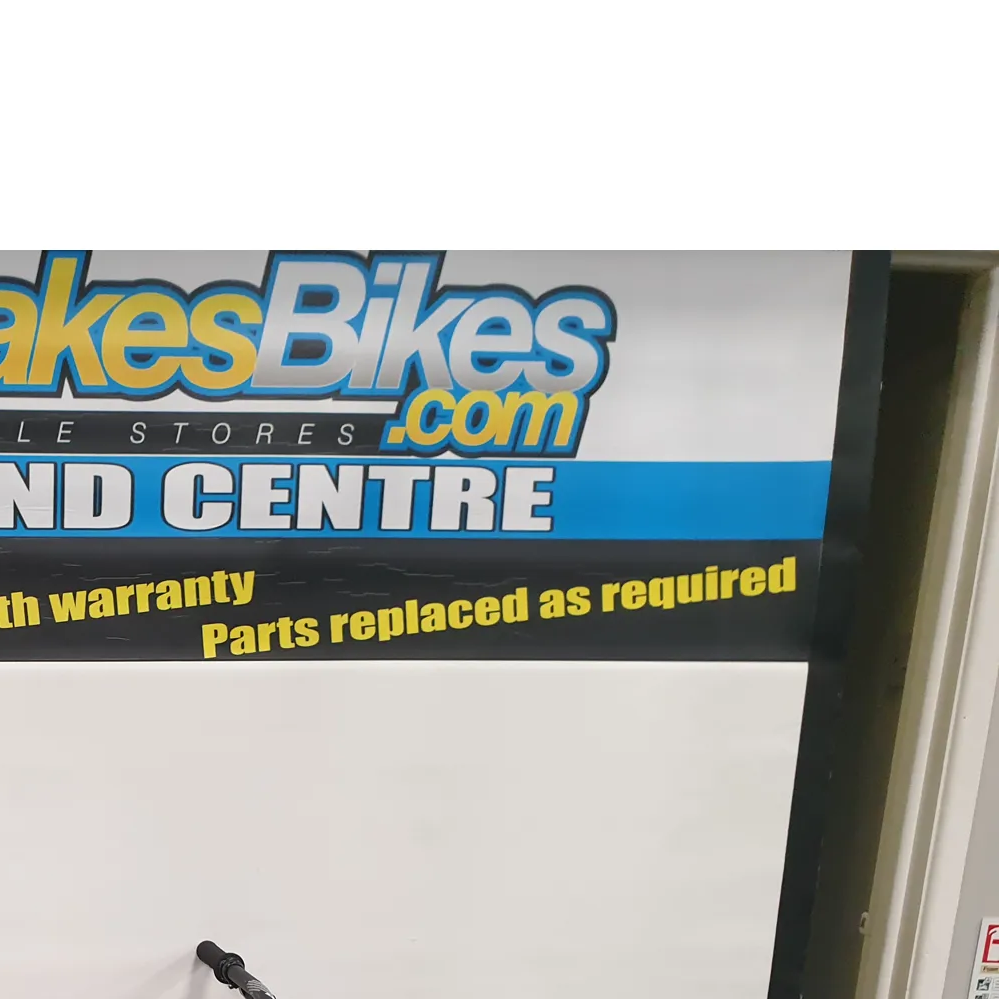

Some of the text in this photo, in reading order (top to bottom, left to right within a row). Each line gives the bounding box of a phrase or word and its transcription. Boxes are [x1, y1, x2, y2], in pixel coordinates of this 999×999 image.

[129, 421, 357, 447] STORES
[161, 461, 555, 532] CENTRE
[48, 570, 255, 623] warranty
[202, 556, 797, 659] Parts replaced as required
